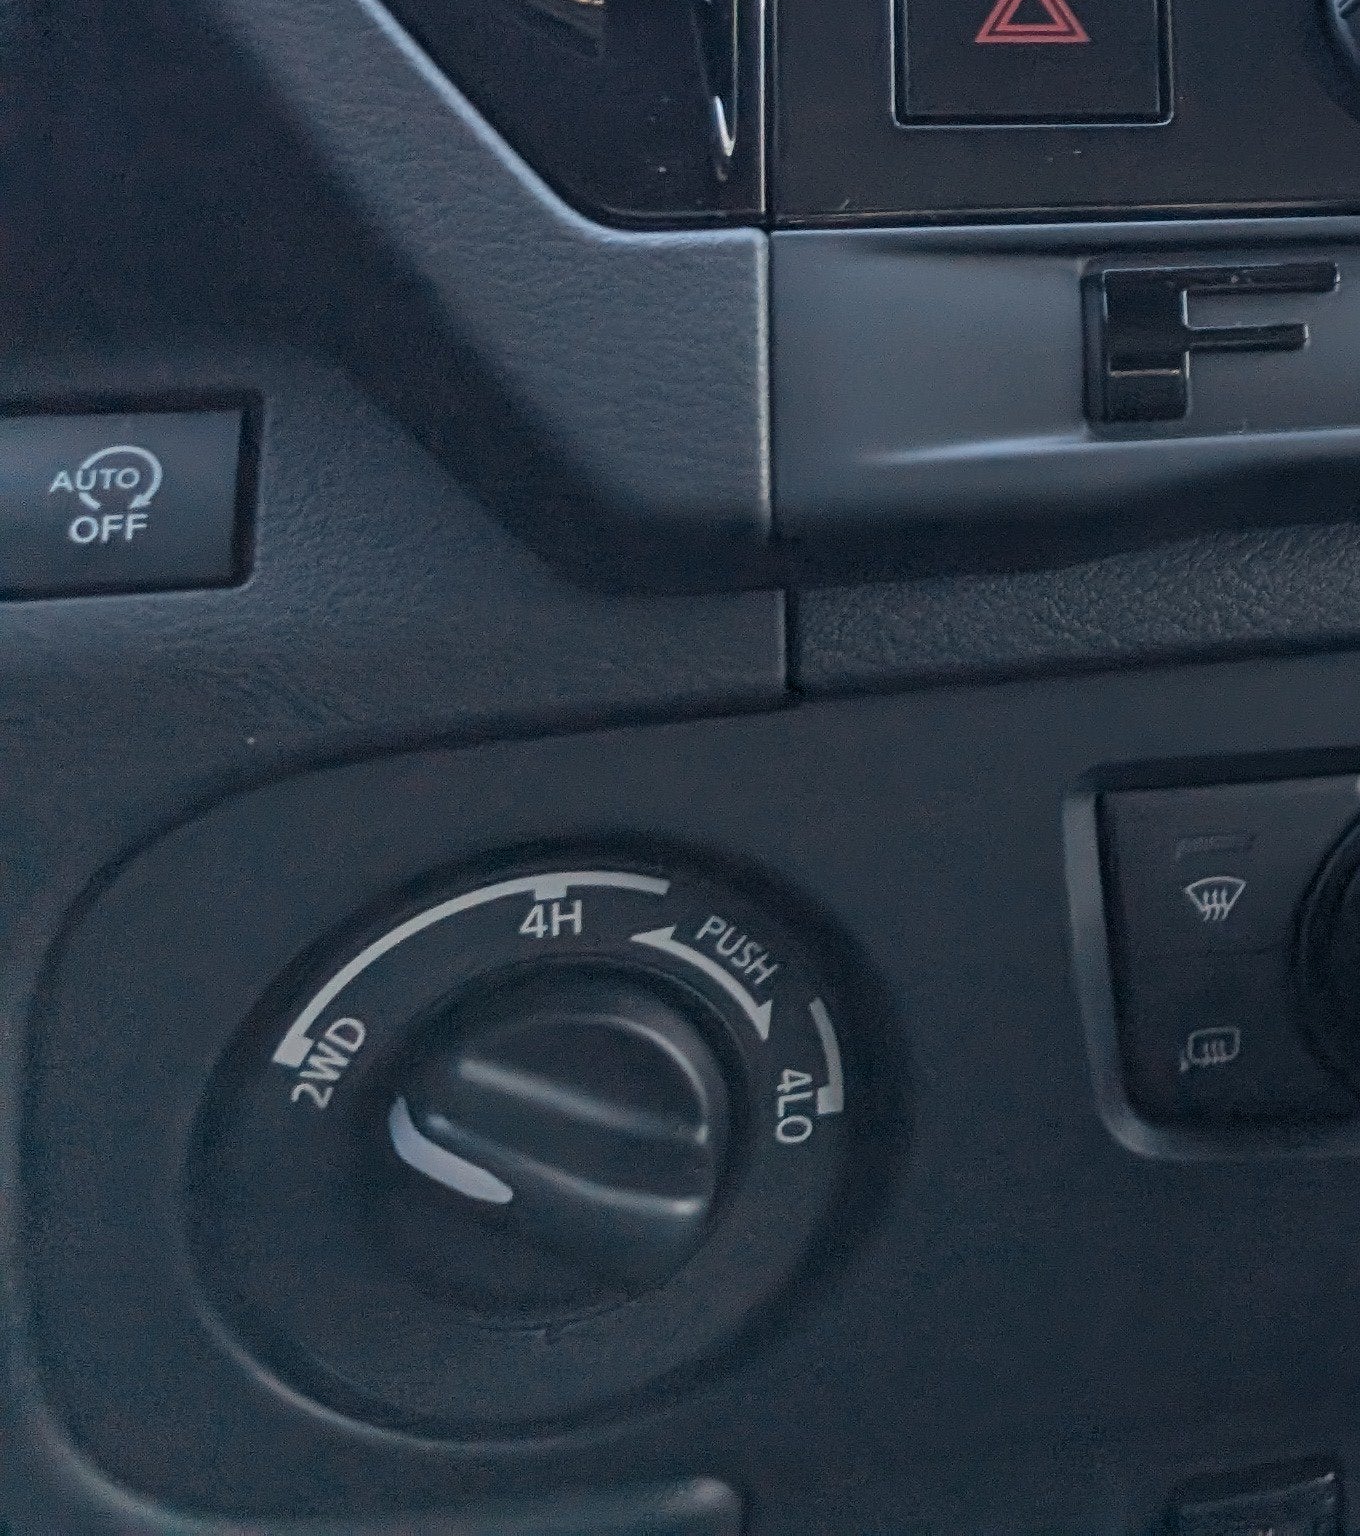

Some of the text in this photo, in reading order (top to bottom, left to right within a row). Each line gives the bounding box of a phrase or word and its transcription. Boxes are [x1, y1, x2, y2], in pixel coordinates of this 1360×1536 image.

[49, 467, 140, 493] AUTO
[68, 514, 148, 544] OFF
[519, 901, 583, 938] 4H
[696, 915, 778, 986] PUSH
[291, 1016, 366, 1109] 2WD
[775, 1068, 812, 1144] 4LO
